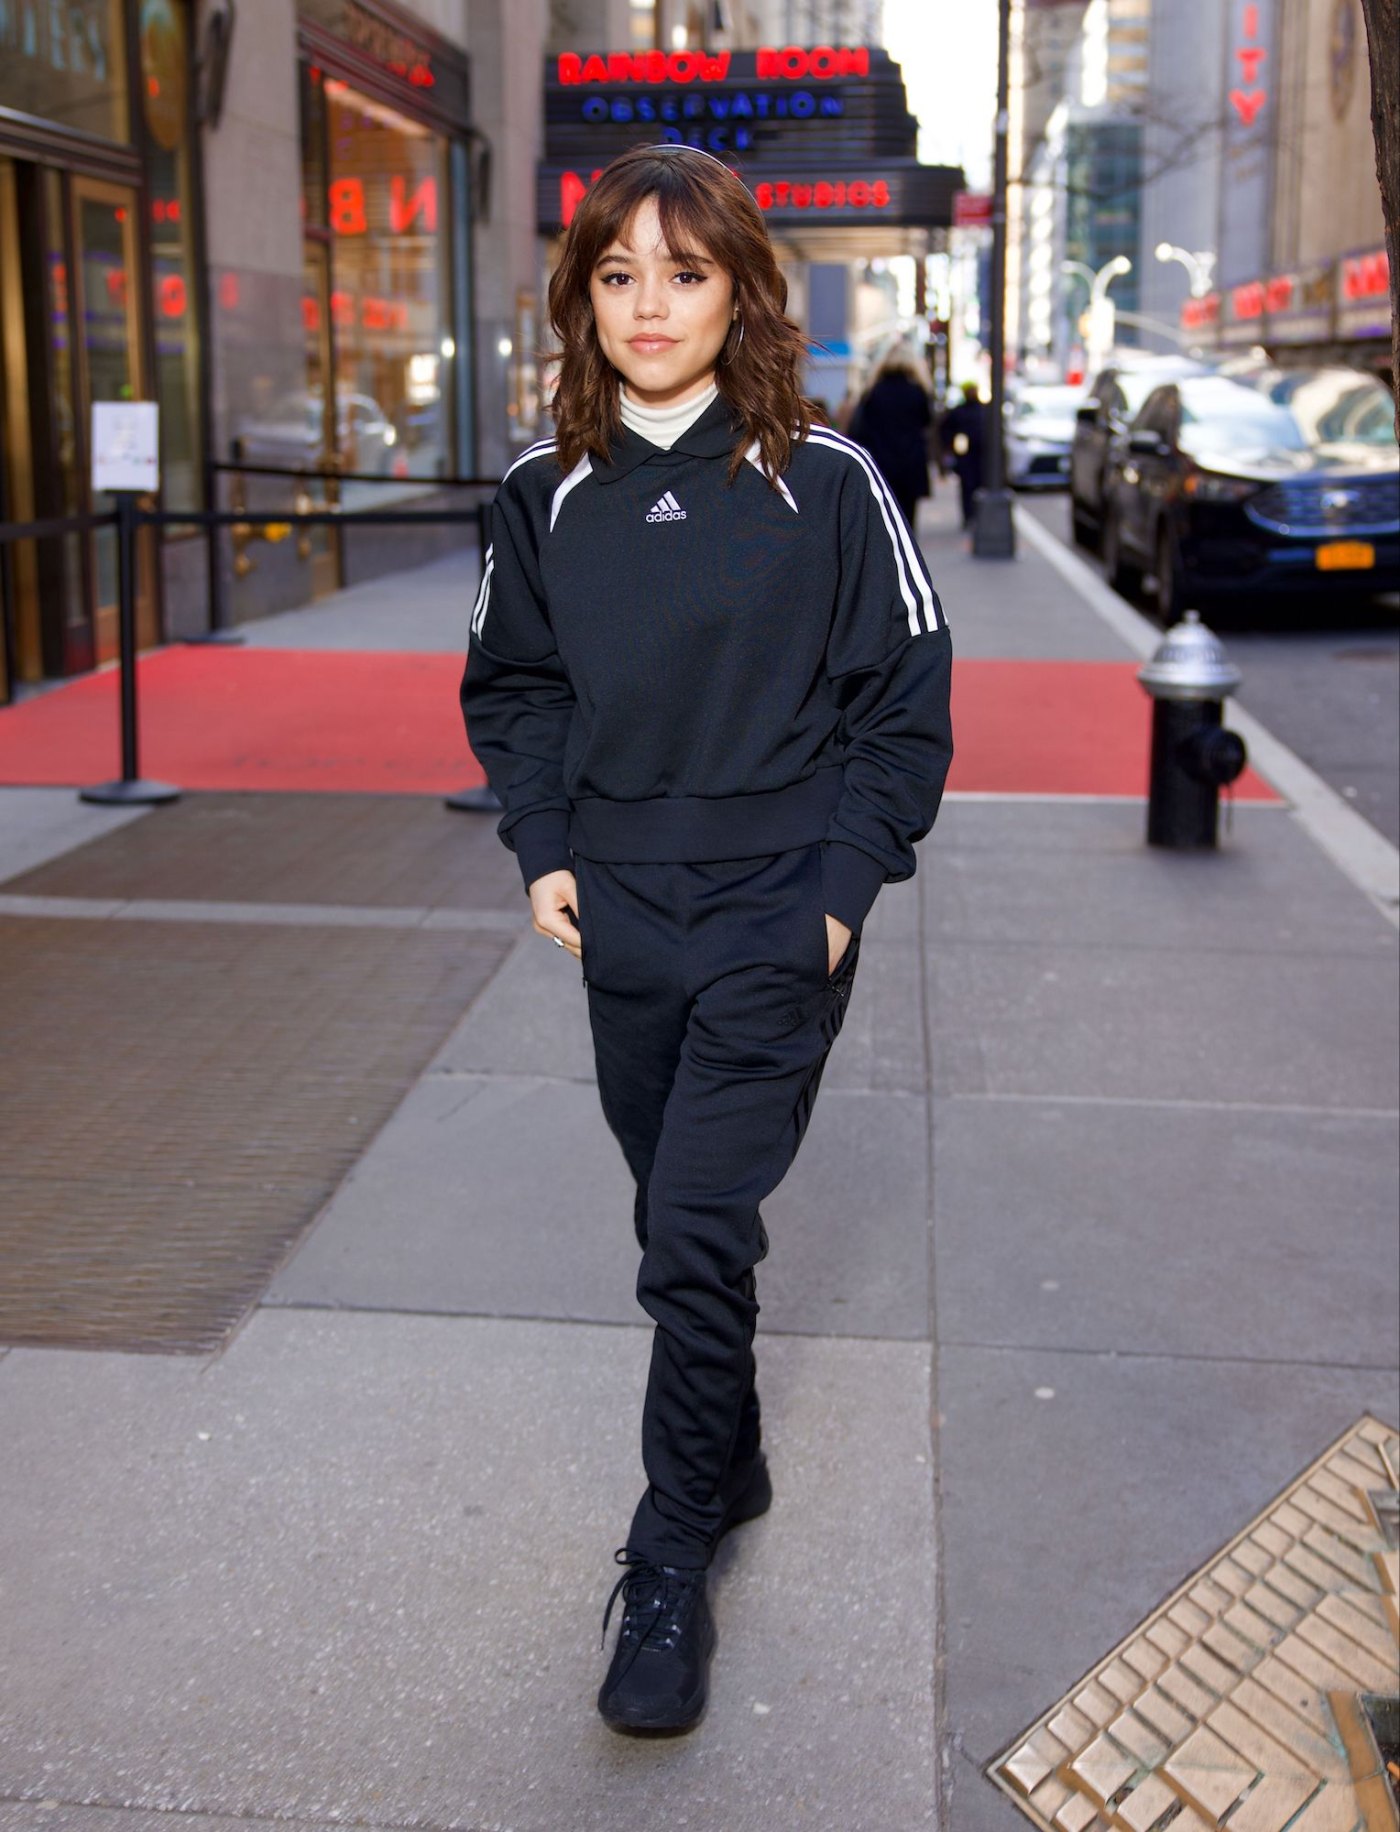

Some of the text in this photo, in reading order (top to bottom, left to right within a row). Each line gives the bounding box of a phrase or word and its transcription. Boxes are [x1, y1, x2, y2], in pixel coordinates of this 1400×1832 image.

[558, 46, 869, 85] RAINBOW ROOM
[582, 92, 843, 122] OBSERVATION
[755, 180, 890, 209] STUDIOS
[645, 510, 687, 523] adidas
